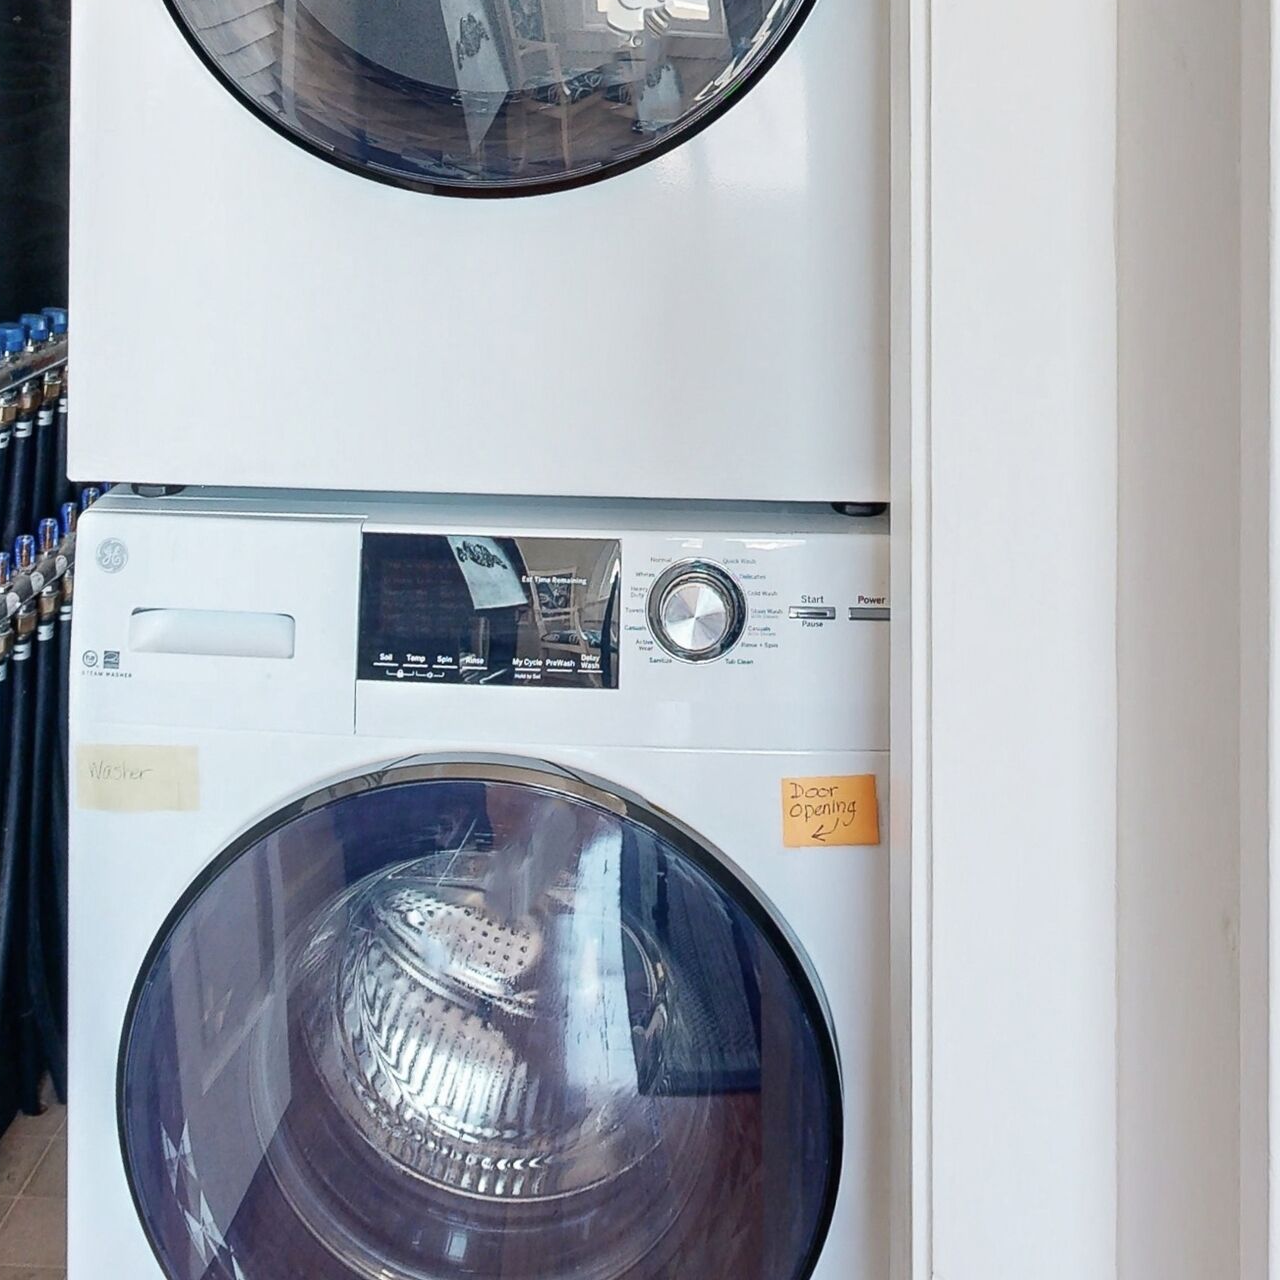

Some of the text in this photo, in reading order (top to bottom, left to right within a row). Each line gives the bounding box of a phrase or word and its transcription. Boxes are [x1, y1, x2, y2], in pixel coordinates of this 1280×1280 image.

[534, 576, 551, 584] Time
[551, 577, 587, 586] Remaining
[801, 595, 824, 604] Start
[858, 596, 885, 605] Power
[801, 621, 823, 629] Pause
[380, 652, 393, 661] Soil
[406, 654, 426, 663] Temp
[437, 655, 453, 664] Spin
[581, 654, 600, 662] Delay
[512, 658, 543, 667] My Cycle
[545, 659, 576, 667] PreWash
[789, 782, 838, 799] Door
